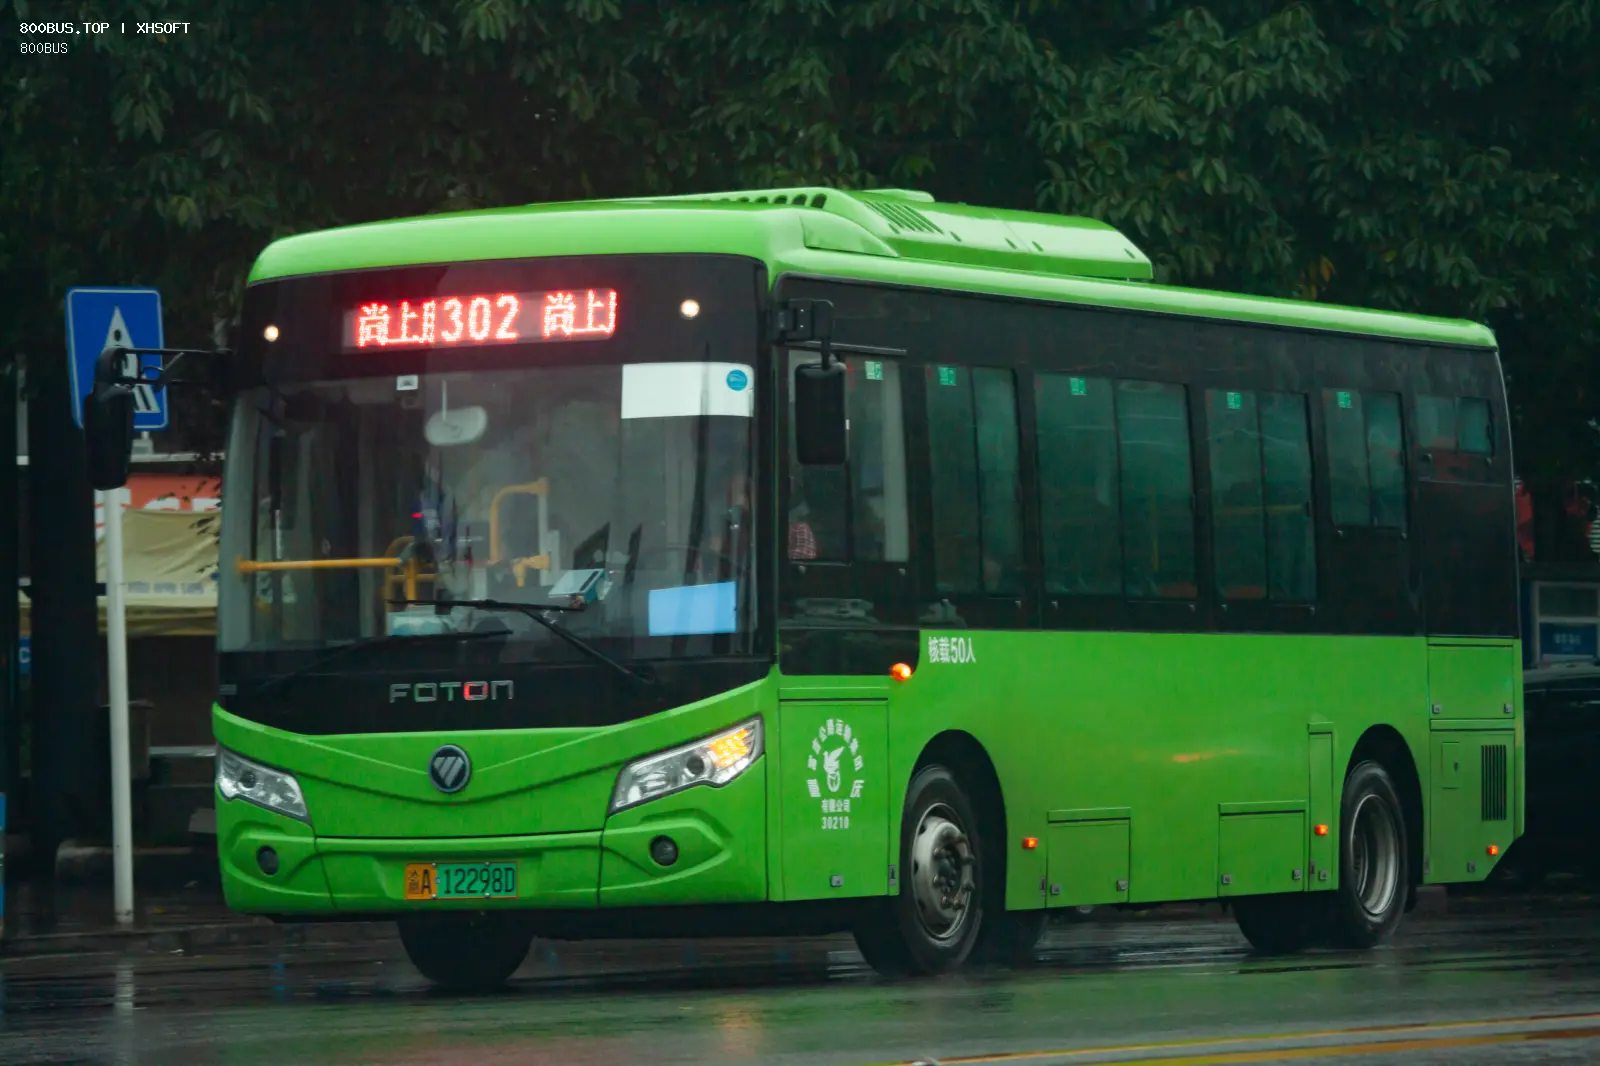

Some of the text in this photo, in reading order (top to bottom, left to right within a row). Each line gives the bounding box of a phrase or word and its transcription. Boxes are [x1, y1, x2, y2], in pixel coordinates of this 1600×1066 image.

[440, 294, 519, 342] 302
[389, 680, 514, 703] FOTON
[444, 867, 515, 894] 12298D
